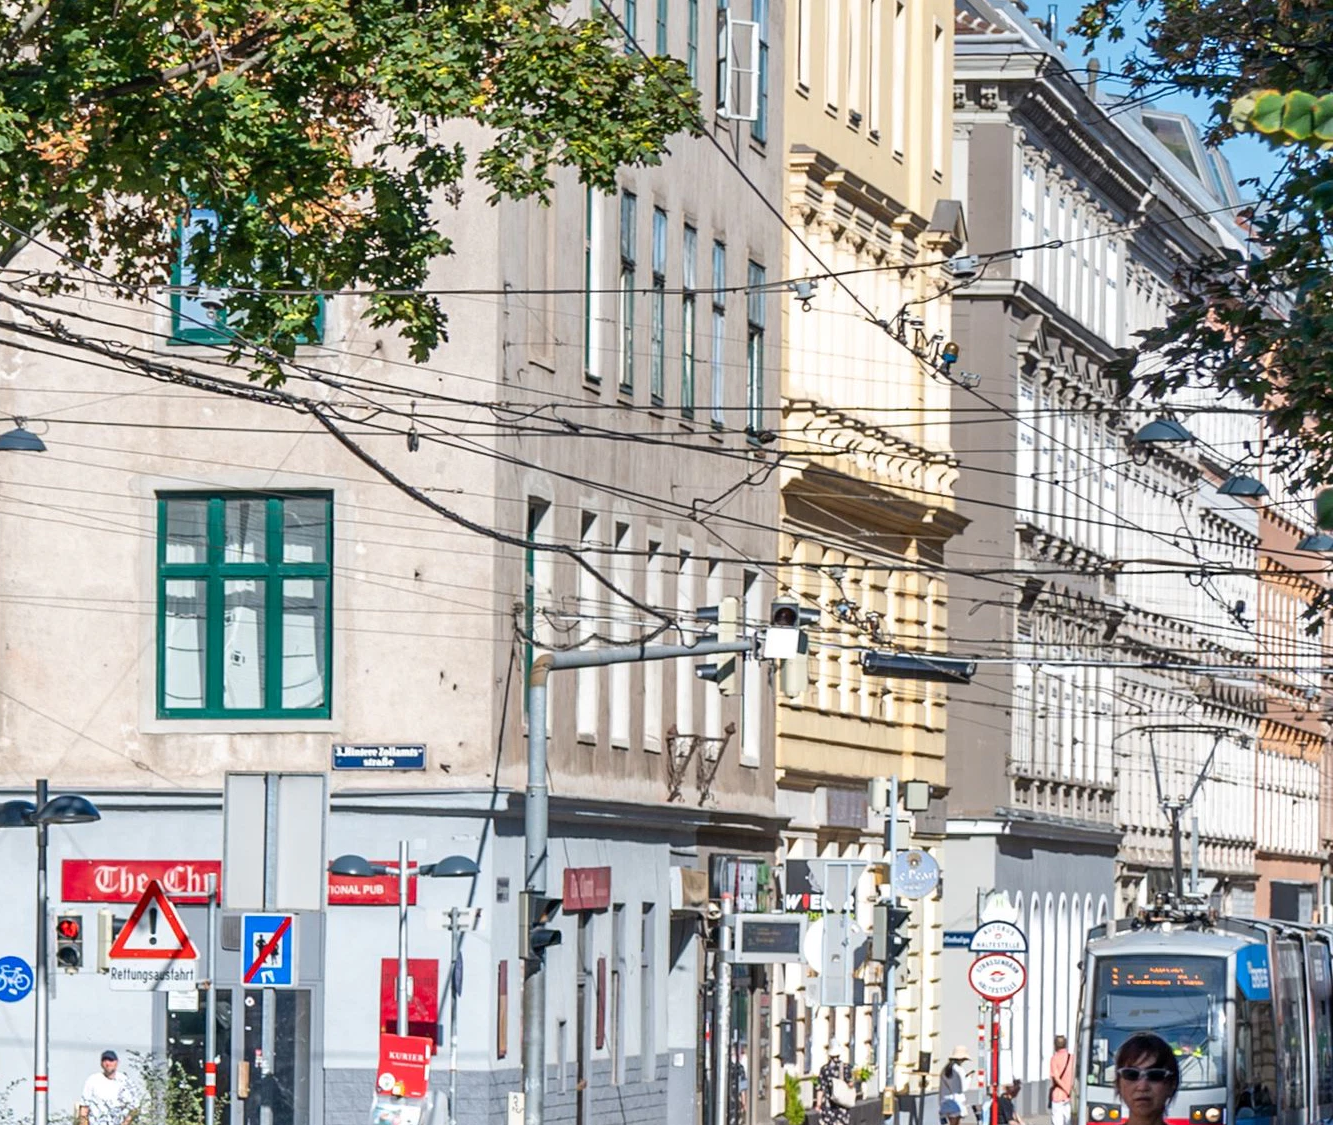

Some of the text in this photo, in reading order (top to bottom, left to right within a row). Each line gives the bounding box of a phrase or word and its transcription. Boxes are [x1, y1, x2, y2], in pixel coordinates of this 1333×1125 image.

[363, 757, 395, 767] straße
[94, 865, 149, 898] The
[362, 884, 384, 895] PUB
[982, 925, 1015, 936] AUTOBUS
[976, 959, 1020, 974] STRASSENBAHN
[111, 967, 195, 983] Rettungsausfahrt
[978, 981, 1017, 994] HALTESTELLE
[389, 1051, 424, 1062] KURIER
